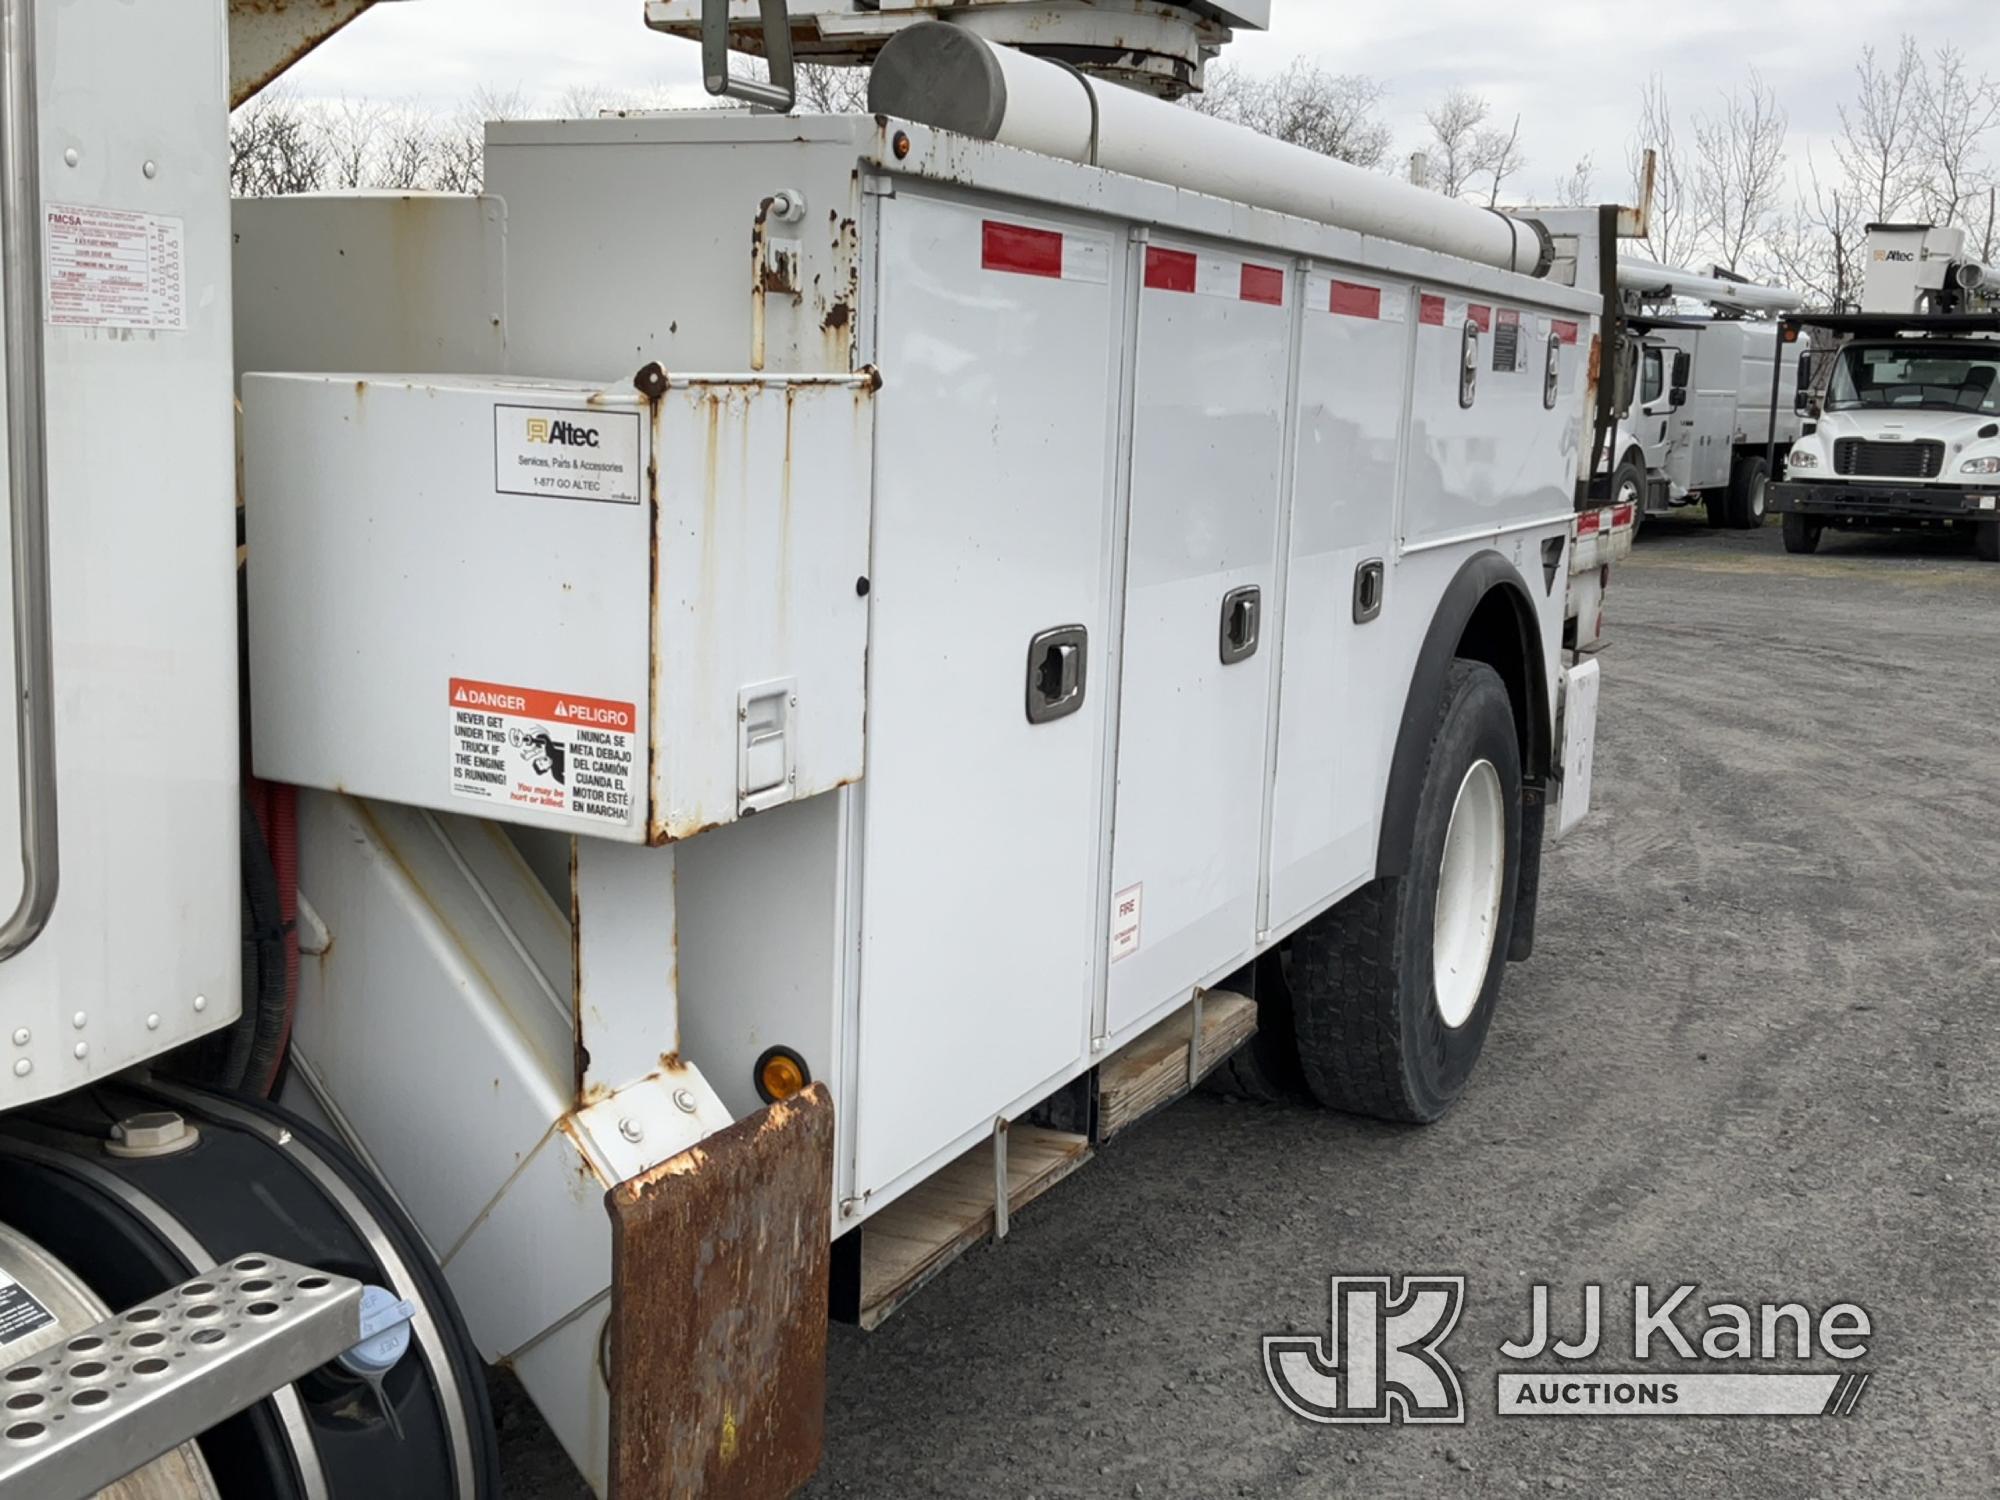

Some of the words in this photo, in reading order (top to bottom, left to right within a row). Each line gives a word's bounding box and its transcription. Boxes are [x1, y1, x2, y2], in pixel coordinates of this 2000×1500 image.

[48, 212, 82, 226] FMCSA
[1886, 249, 1914, 262] Altec
[548, 420, 600, 448] Altec
[518, 455, 551, 469] Services,
[552, 457, 570, 470] Parts
[580, 460, 623, 473] Accessories
[534, 477, 554, 488] 1-877
[557, 479, 571, 489] GO
[572, 480, 600, 492] ALTEC
[469, 690, 526, 711] DANGER
[456, 712, 485, 727] NEVER
[487, 716, 504, 728] GET
[569, 705, 628, 726] PELIGRO
[455, 726, 483, 740] UNDER
[486, 730, 506, 743] THIS
[615, 735, 625, 747] SE
[461, 740, 489, 754] TRUCK
[492, 745, 500, 756] IF
[569, 743, 594, 757] META
[596, 747, 632, 763] DEBAJO
[456, 753, 472, 766] THE
[474, 756, 505, 771] ENGINE
[573, 758, 589, 771] DEL
[592, 760, 628, 777] CAMIÓN
[454, 767, 462, 777] IS
[465, 768, 507, 785] RUNNING!
[575, 773, 612, 788] CUANDA
[614, 778, 626, 791] EL
[517, 783, 532, 793] You
[534, 787, 551, 797] may
[554, 788, 564, 798] be
[572, 786, 604, 801] MOTOR
[606, 790, 629, 806] ESTÉ
[510, 792, 528, 802] hurt
[529, 795, 538, 803] or
[540, 795, 565, 808] killed.
[572, 800, 584, 812] EN
[586, 802, 629, 820] MARCHA!
